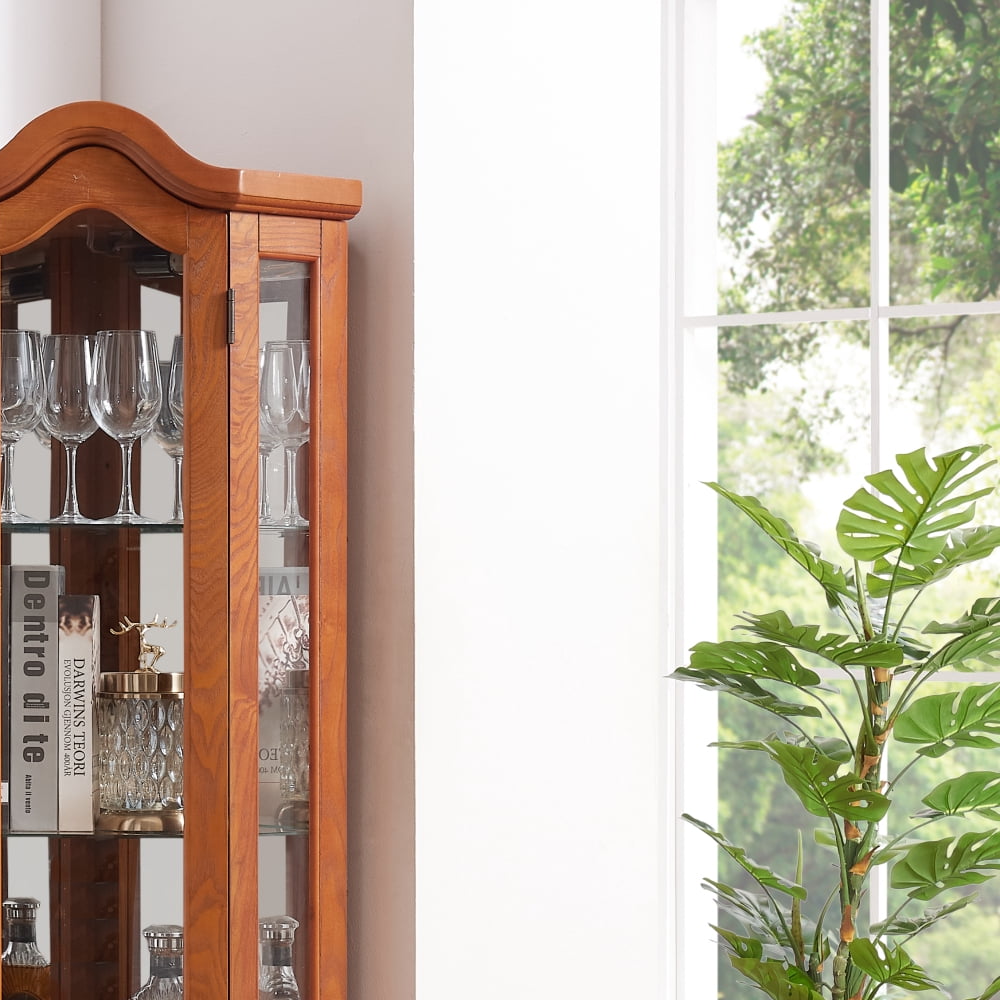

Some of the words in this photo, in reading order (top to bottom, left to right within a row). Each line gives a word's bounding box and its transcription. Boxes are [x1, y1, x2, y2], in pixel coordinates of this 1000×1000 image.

[22, 570, 50, 677] Dentro
[62, 659, 72, 707] EVOLUSJON
[73, 658, 86, 727] DARWINS
[22, 692, 50, 722] di
[62, 709, 72, 751] GJENNOM
[22, 733, 49, 763] te
[73, 731, 86, 777] TEORI
